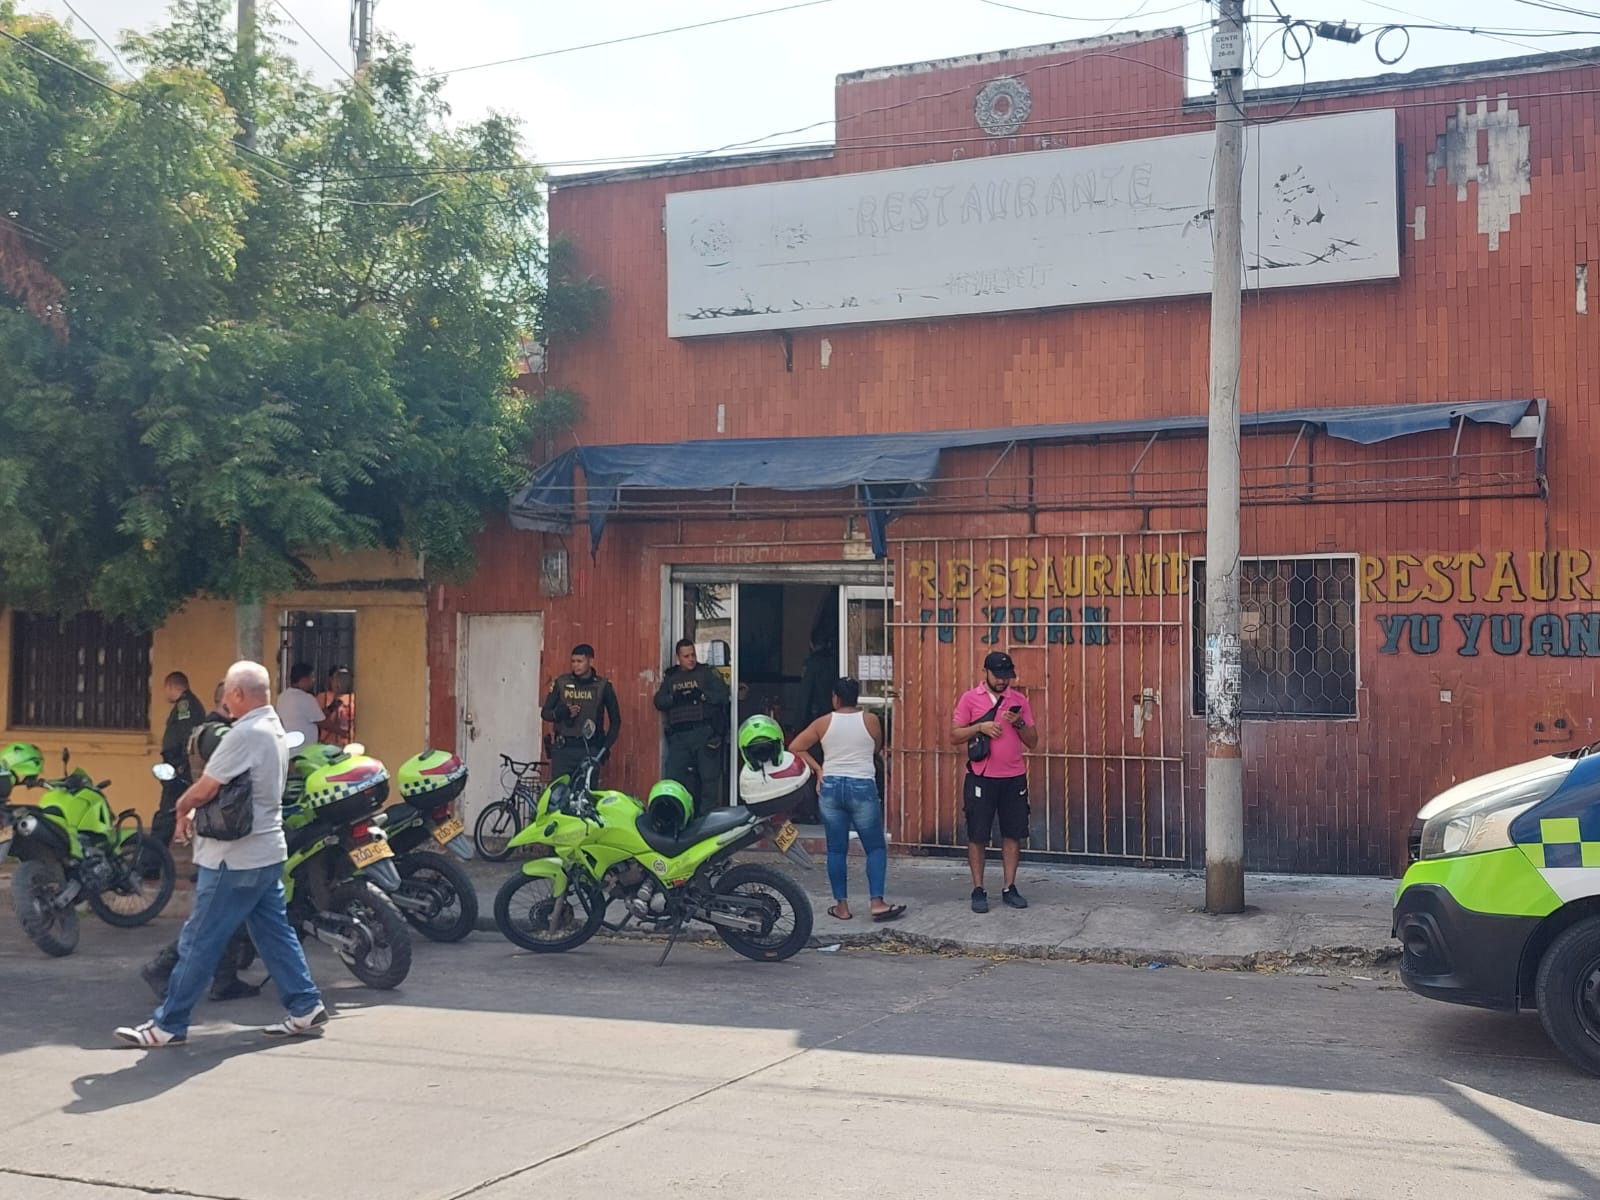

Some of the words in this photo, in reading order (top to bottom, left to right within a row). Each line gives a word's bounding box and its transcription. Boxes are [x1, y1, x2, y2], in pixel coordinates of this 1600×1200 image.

[856, 162, 1153, 237] RESTAURANTE
[908, 552, 1190, 601] RESTAURANTE
[1359, 550, 1600, 603] RESTAUR
[981, 605, 1111, 646] YUAN
[1376, 613, 1442, 655] YU
[1453, 612, 1600, 658] YUAN
